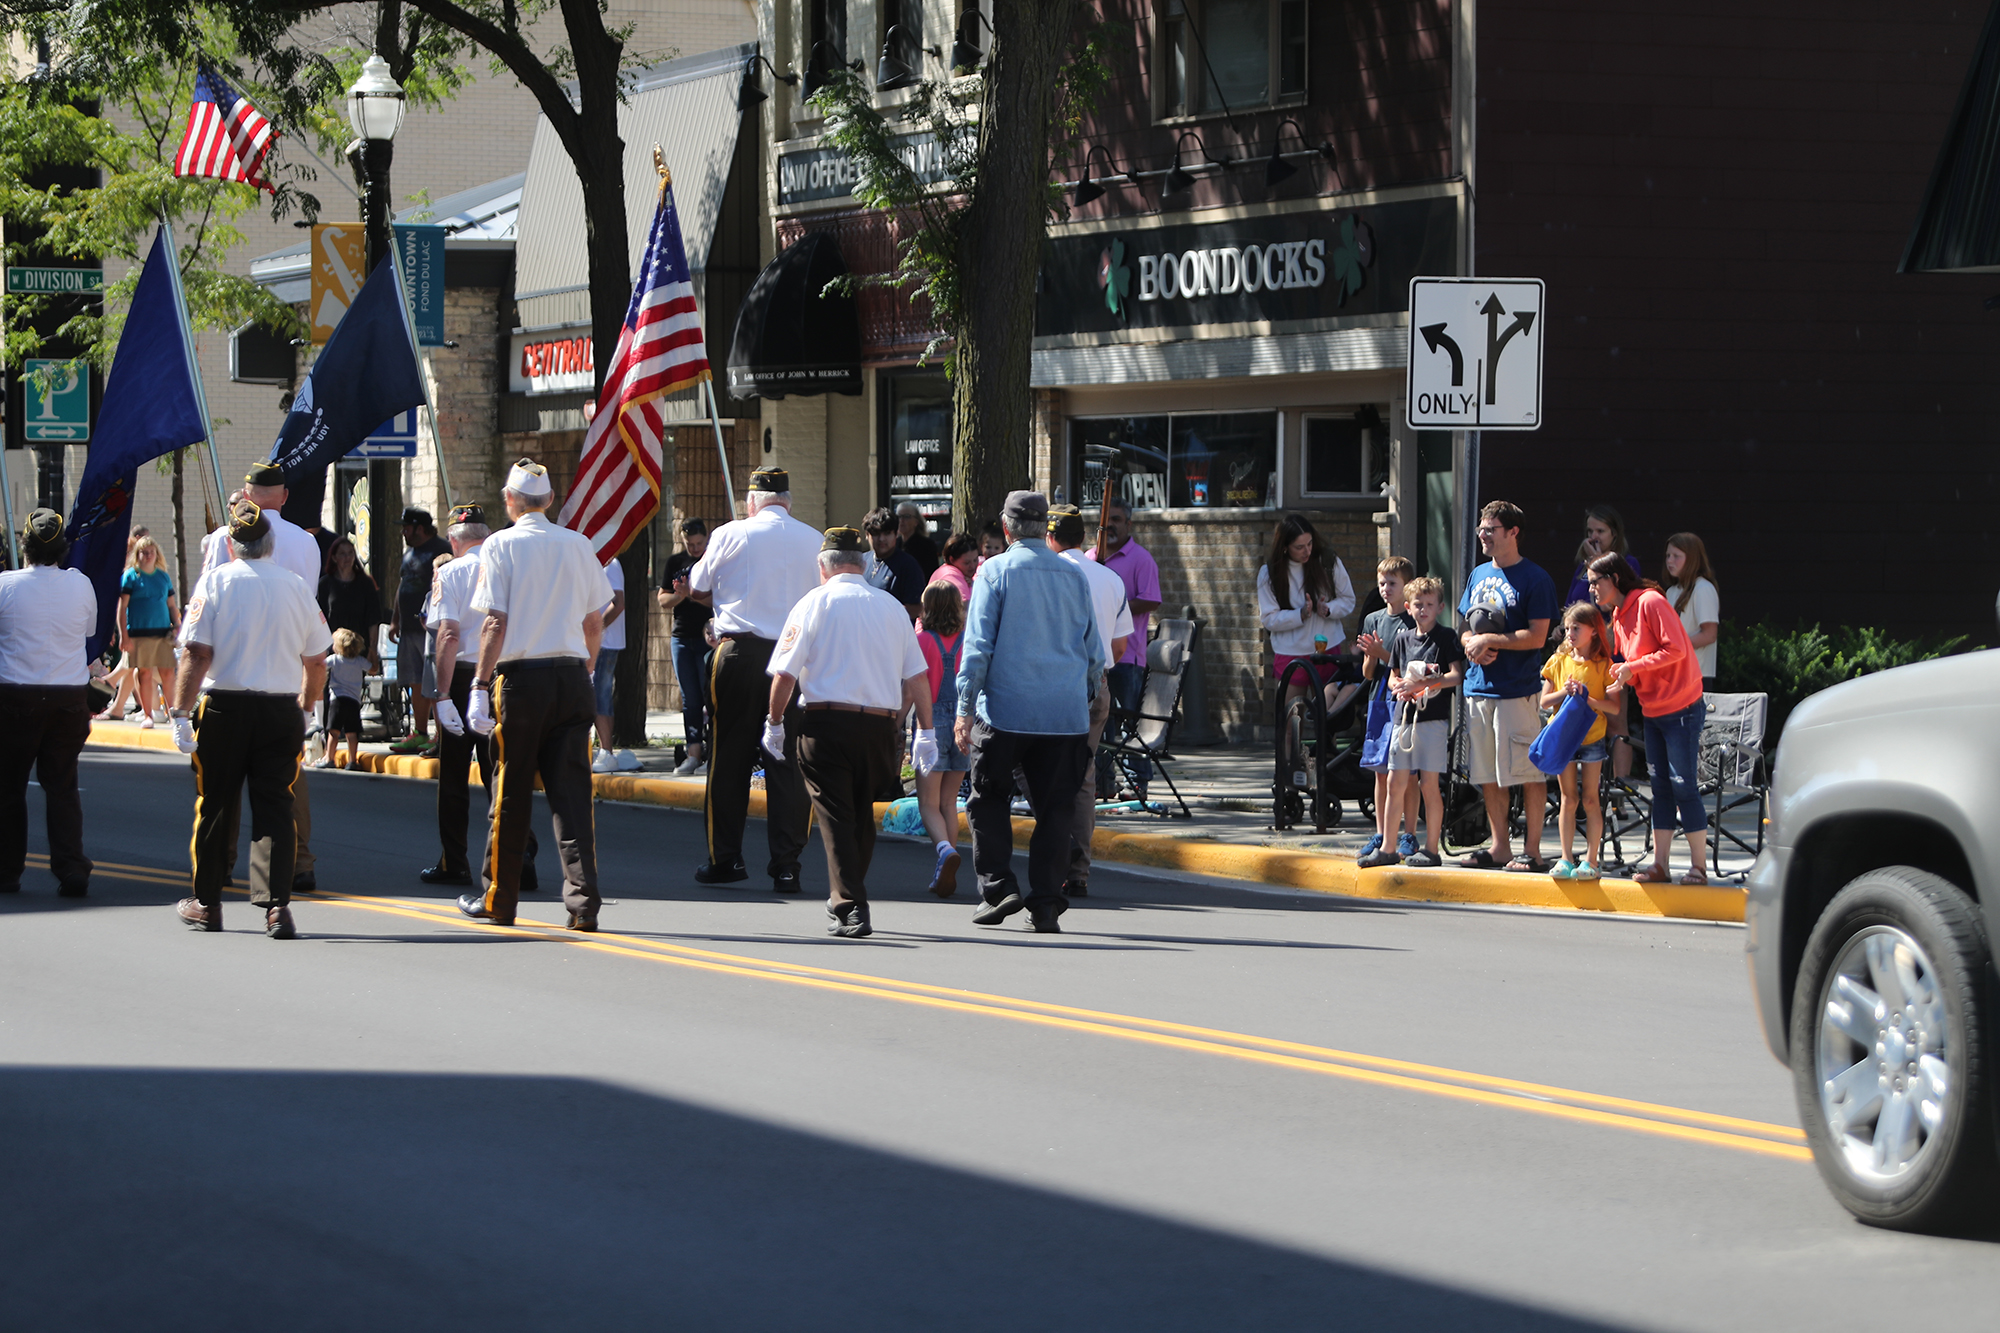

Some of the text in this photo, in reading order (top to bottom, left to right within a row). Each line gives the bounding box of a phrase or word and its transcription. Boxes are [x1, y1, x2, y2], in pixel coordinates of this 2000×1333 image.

[780, 163, 808, 194] LAW
[809, 156, 856, 189] OFFICE
[12, 271, 100, 290] W DIVISION ST
[421, 240, 430, 312] FOND DU LAC
[1138, 239, 1325, 301] BOONDOCKS
[521, 335, 593, 378] CENTRAL
[732, 369, 737, 386] 6
[755, 372, 774, 380] OFFICE
[776, 371, 785, 379] OF
[788, 370, 806, 378] JOHN
[818, 369, 850, 377] HERRICK
[1418, 392, 1474, 414] ONLY
[763, 426, 772, 453] 6
[904, 439, 940, 454] LAW OFFICE
[917, 457, 927, 472] OF
[891, 475, 906, 489] JOHN
[1121, 472, 1166, 509] OPEN
[1500, 582, 1516, 607] EVER
